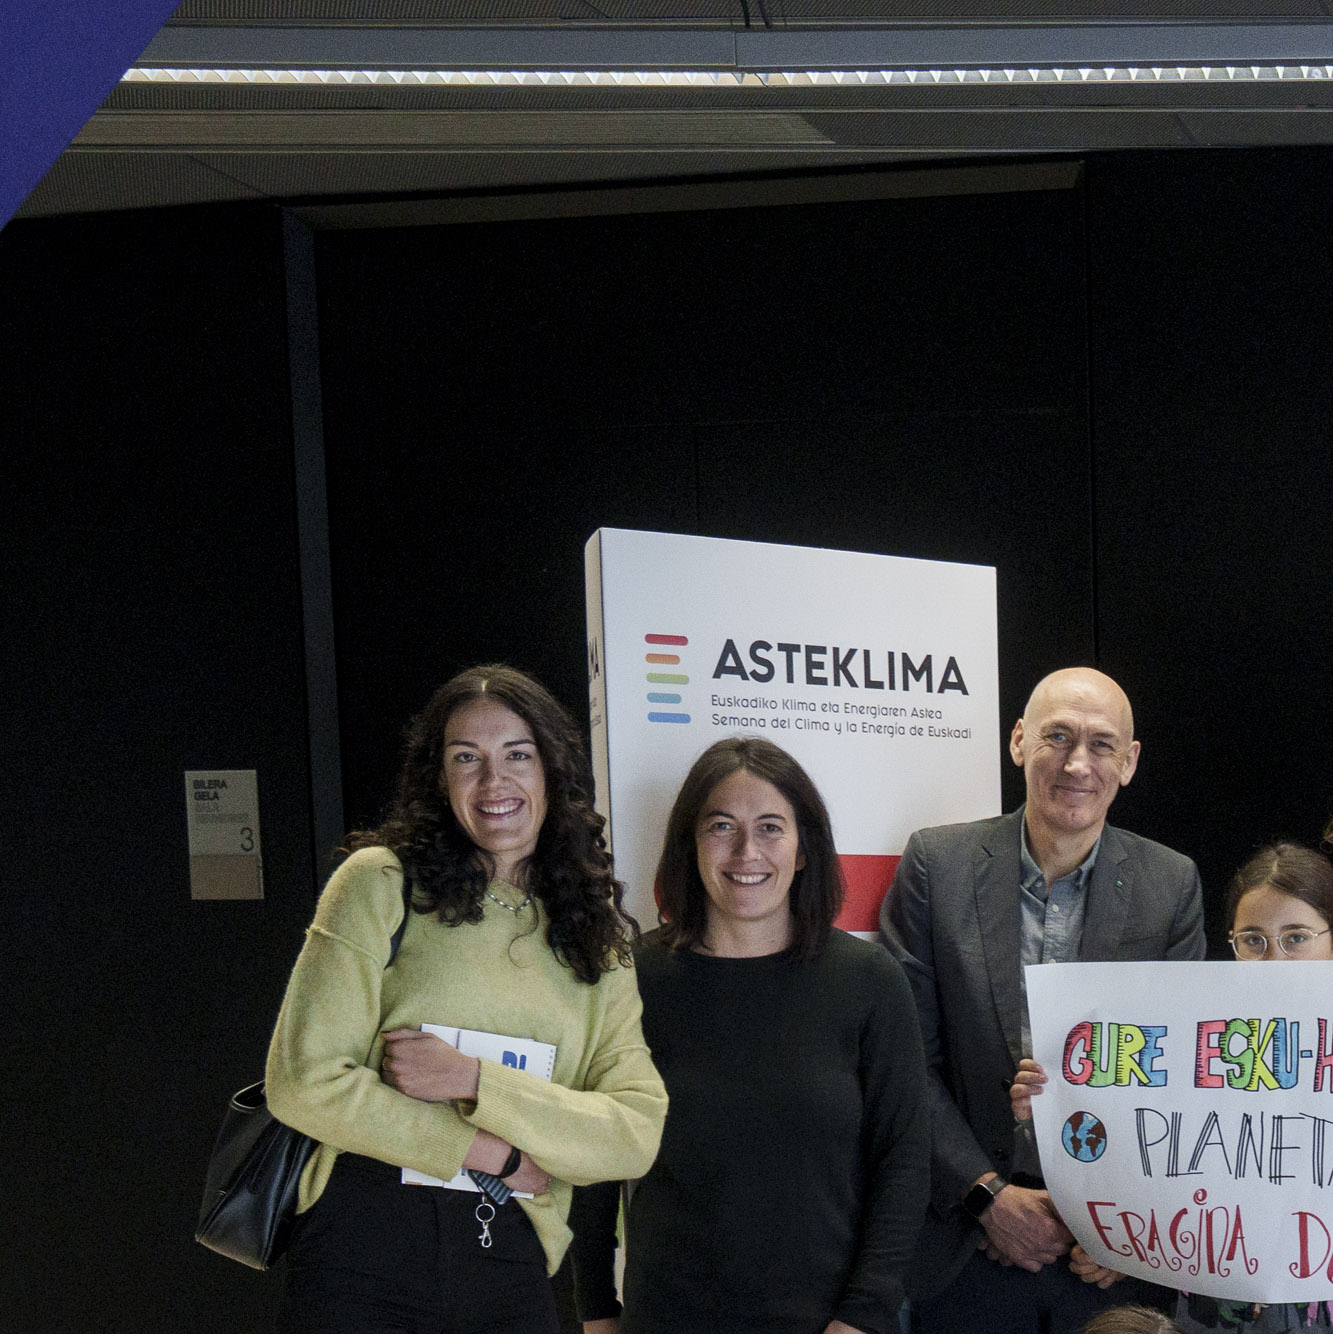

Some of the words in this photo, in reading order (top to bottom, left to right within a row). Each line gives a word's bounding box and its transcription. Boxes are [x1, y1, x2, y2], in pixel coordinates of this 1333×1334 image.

[712, 638, 969, 696] ASTEKLIMA
[711, 695, 778, 710] Euskadiko
[782, 698, 816, 712] Klima
[821, 701, 839, 714] eta
[844, 703, 907, 719] Energiaren
[911, 707, 942, 720] Astea
[712, 714, 766, 728] Semana
[771, 717, 790, 729] del
[795, 718, 830, 732] Clima
[834, 723, 841, 735] y
[846, 721, 857, 733] la
[862, 722, 905, 738] Energía
[909, 725, 924, 737] de
[928, 726, 972, 739] Euskadi
[240, 827, 254, 852] 3
[1062, 1021, 1168, 1088] GURE
